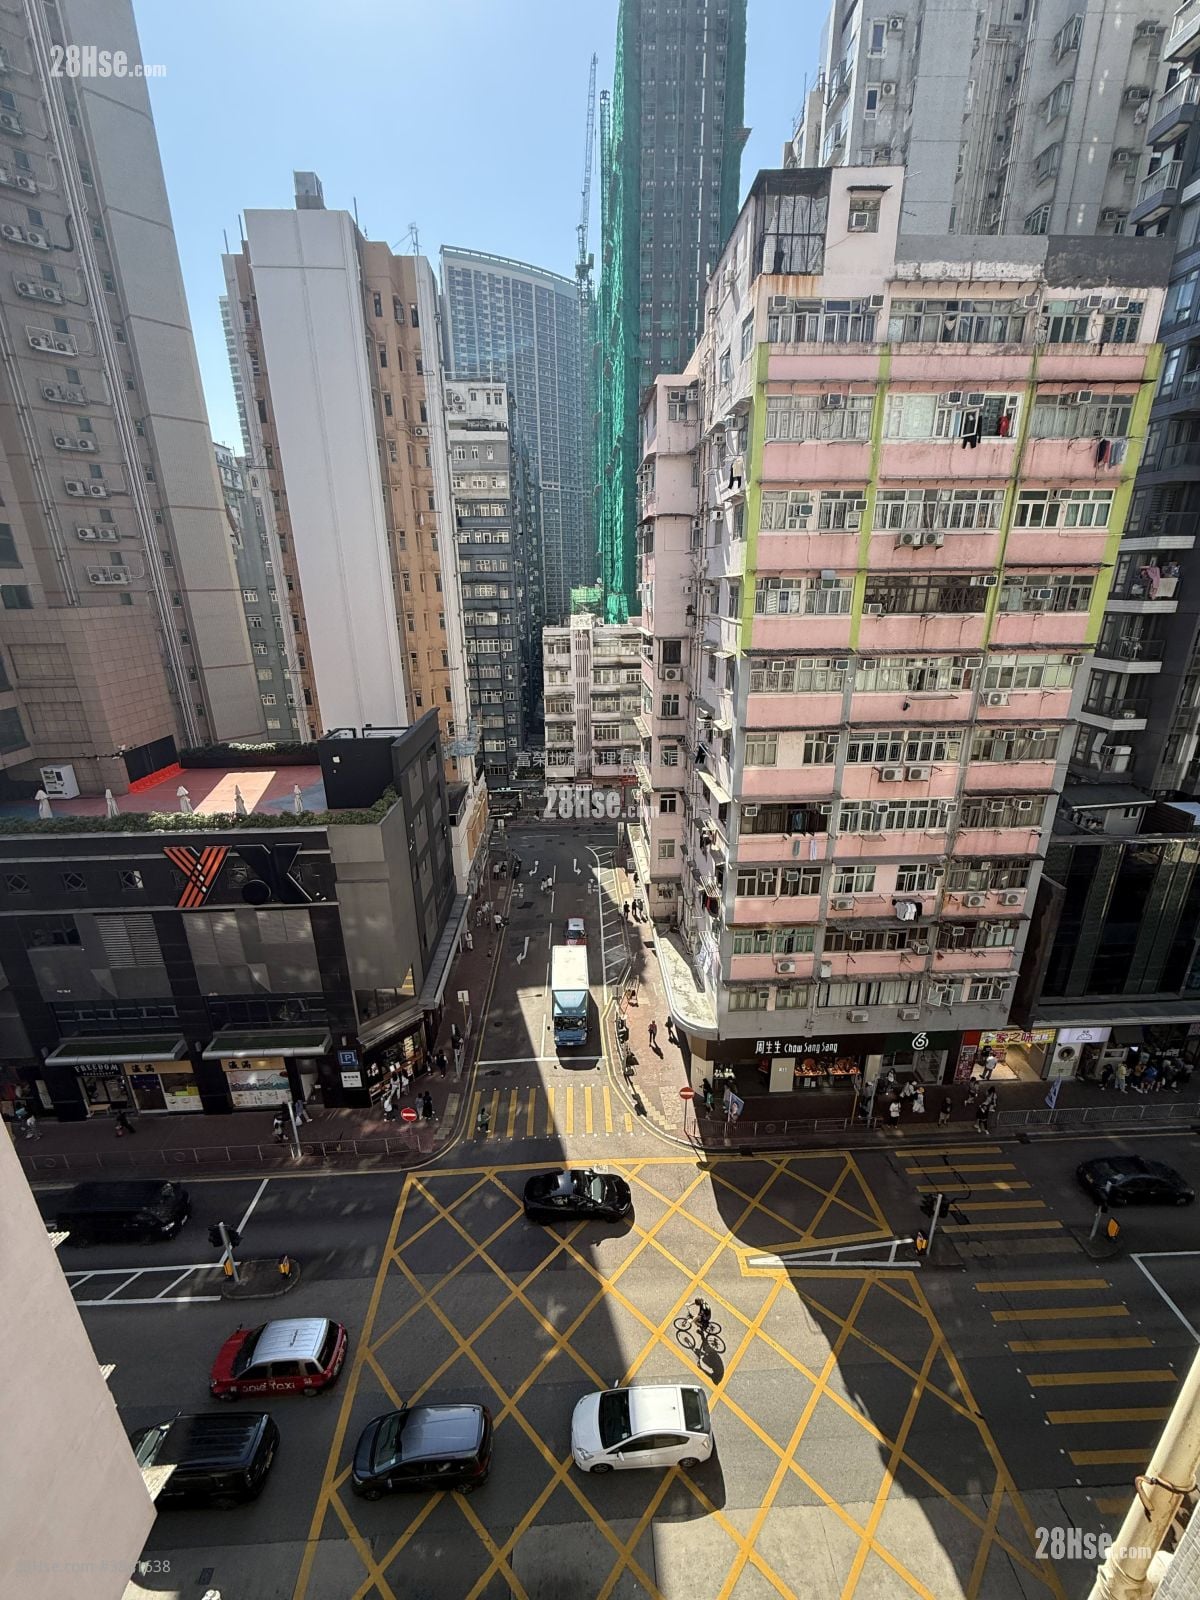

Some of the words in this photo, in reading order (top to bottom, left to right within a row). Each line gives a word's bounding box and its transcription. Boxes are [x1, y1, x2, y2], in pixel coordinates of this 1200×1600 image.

[755, 1040, 781, 1054] 周生生
[784, 1043, 802, 1053] Chow
[804, 1042, 820, 1054] Sang
[822, 1042, 838, 1053] Sang
[74, 1063, 119, 1072] FREEDOM
